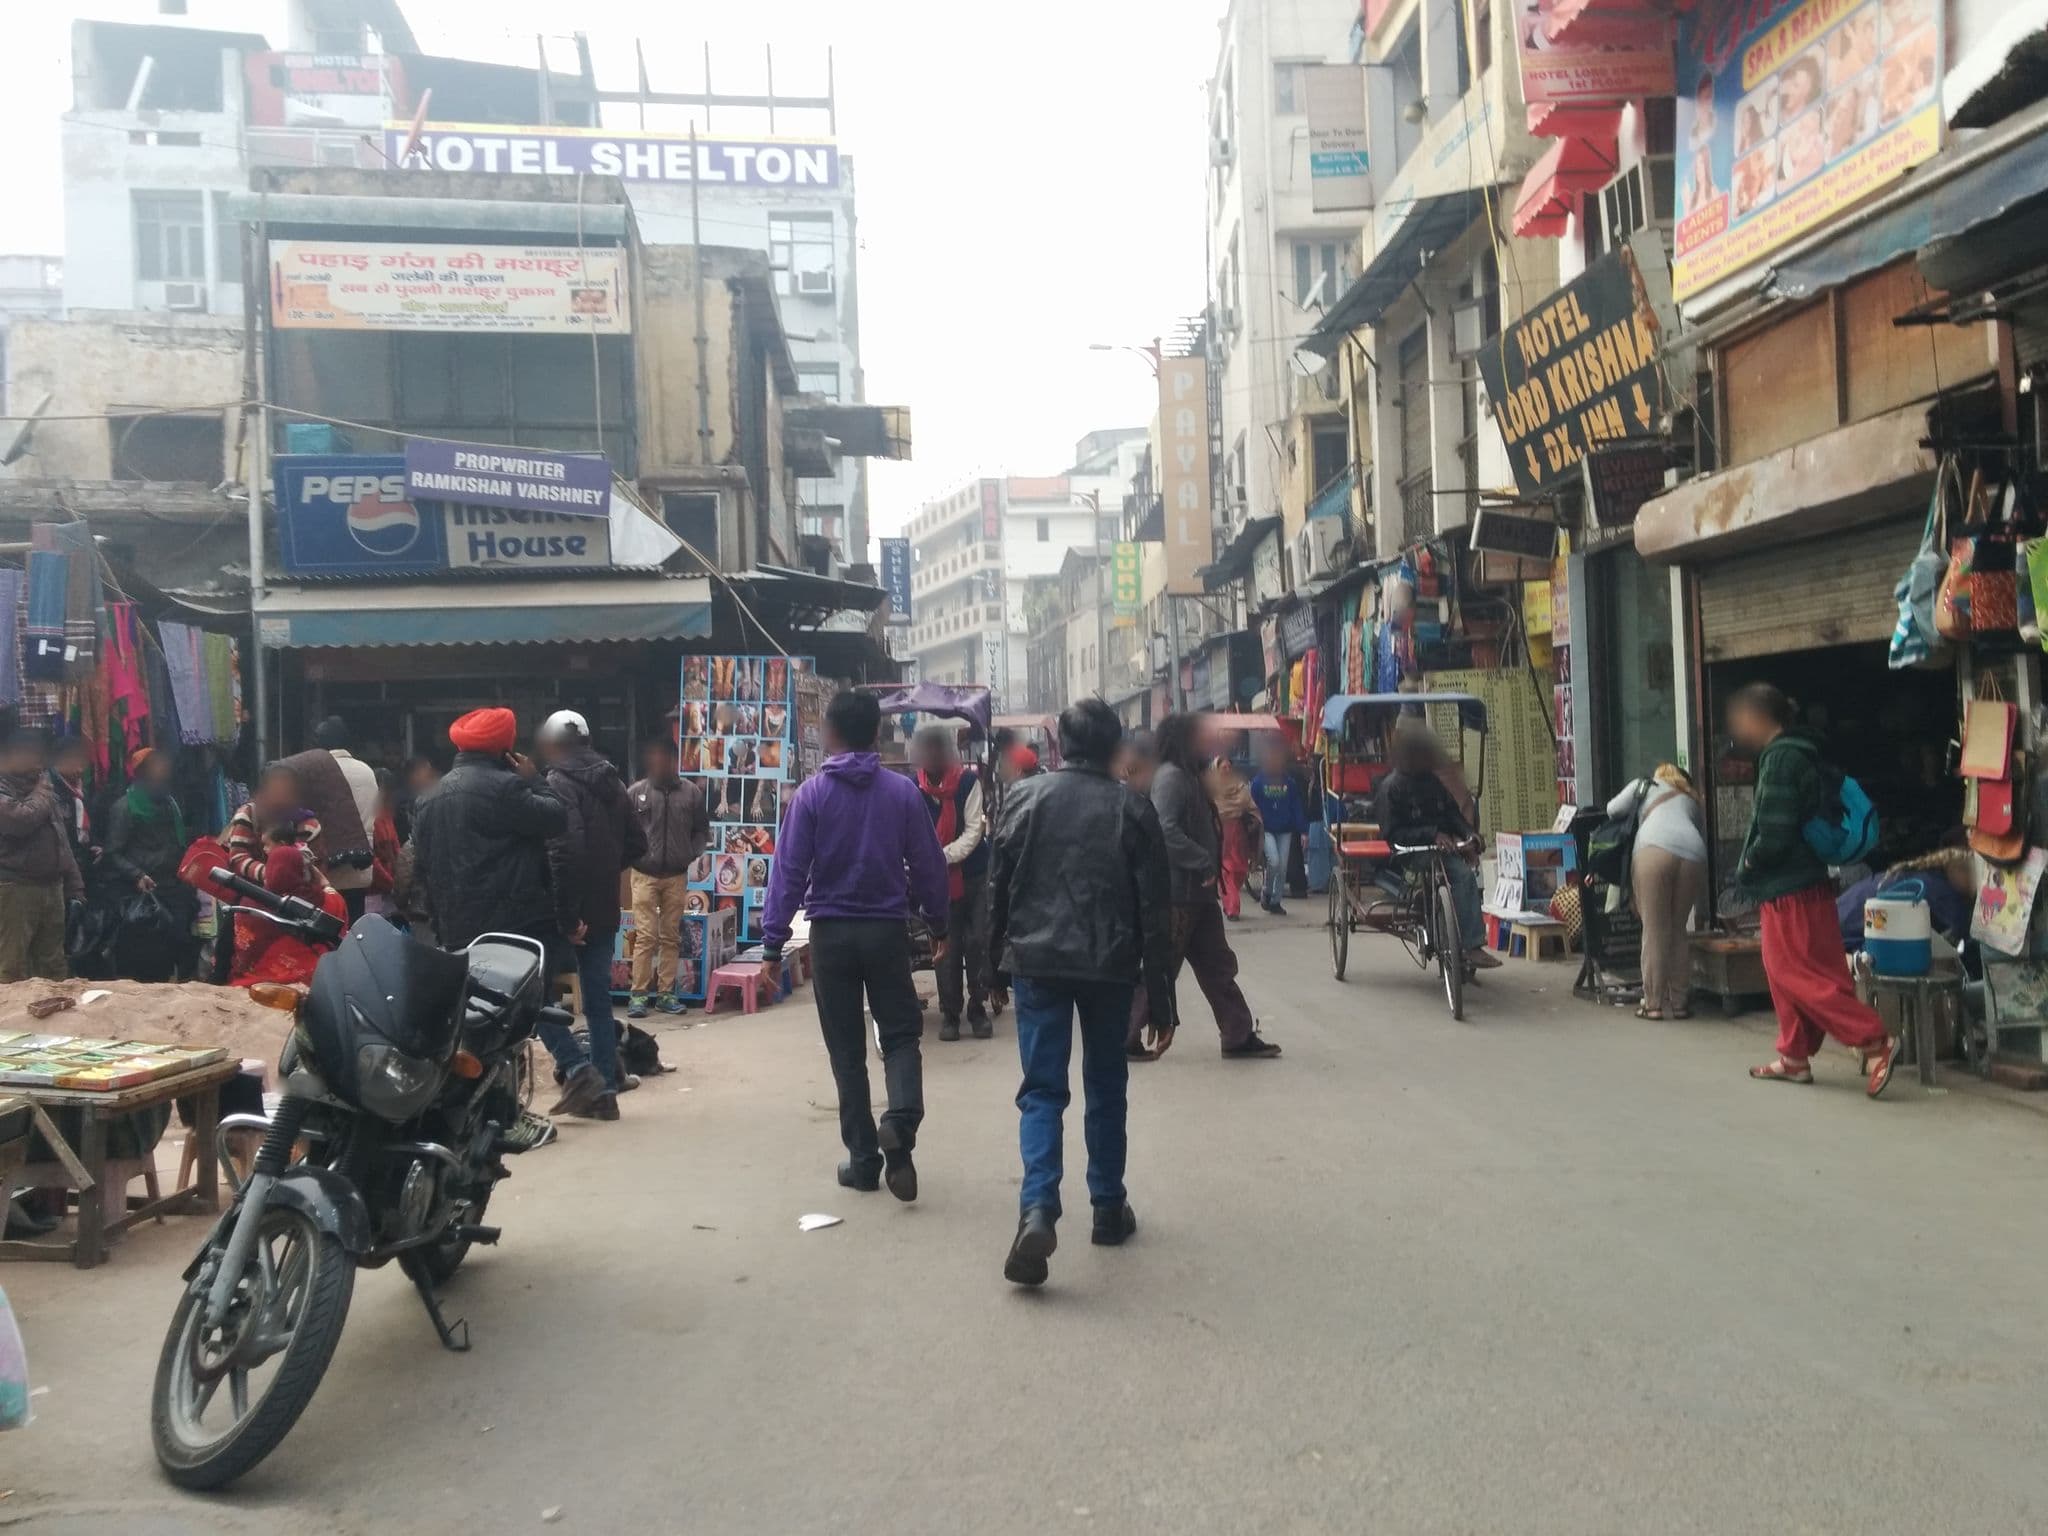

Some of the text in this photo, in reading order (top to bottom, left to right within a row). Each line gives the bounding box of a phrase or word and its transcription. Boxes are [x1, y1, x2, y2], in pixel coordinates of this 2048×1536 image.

[1529, 69, 1570, 81] HOTEL
[1747, 44, 1774, 79] SPA
[394, 136, 829, 185] HOTEL SHELTON
[380, 251, 436, 269] गंज
[446, 252, 484, 270] की
[495, 256, 581, 278] मशहूर
[1516, 290, 1591, 368] HOTEL
[1495, 311, 1656, 445] LORD KRISHNA
[1579, 396, 1627, 452] INN
[454, 451, 565, 479] PROPWRITER
[1173, 370, 1200, 545] PAYAL
[301, 475, 408, 504] PEPS
[411, 471, 605, 507] RAMKISHAN VARSHNEY
[467, 530, 587, 562] House
[890, 547, 905, 614] SHELTON
[1115, 543, 1136, 601] GURU
